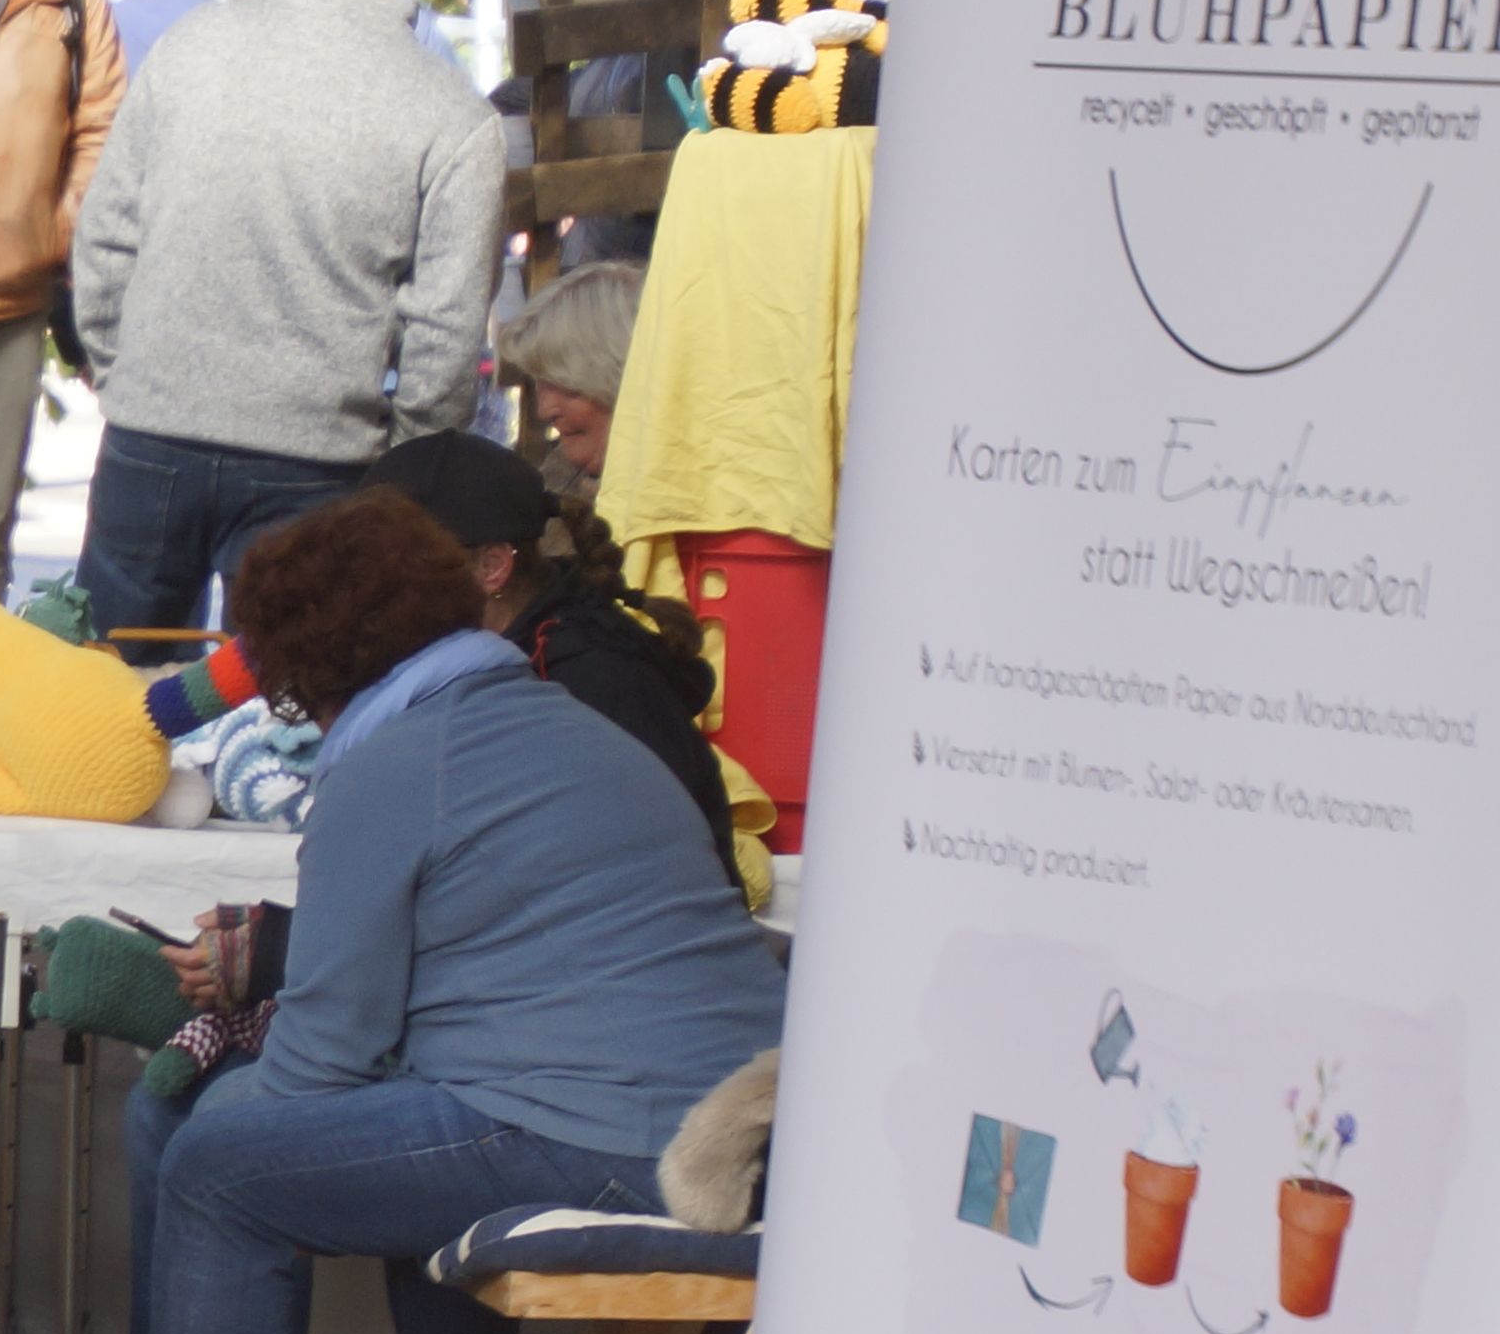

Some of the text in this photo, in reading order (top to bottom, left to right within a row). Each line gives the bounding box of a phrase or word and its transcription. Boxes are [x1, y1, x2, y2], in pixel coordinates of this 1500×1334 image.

[1080, 93, 1481, 144] recycelt geschöpft gepflanzt
[947, 423, 1062, 488] Karten
[1073, 451, 1137, 495] zum
[1080, 536, 1432, 620] statt Wegschmeißen!
[941, 647, 980, 684] Auf
[1174, 673, 1243, 721] Papier
[1249, 693, 1287, 724] aus
